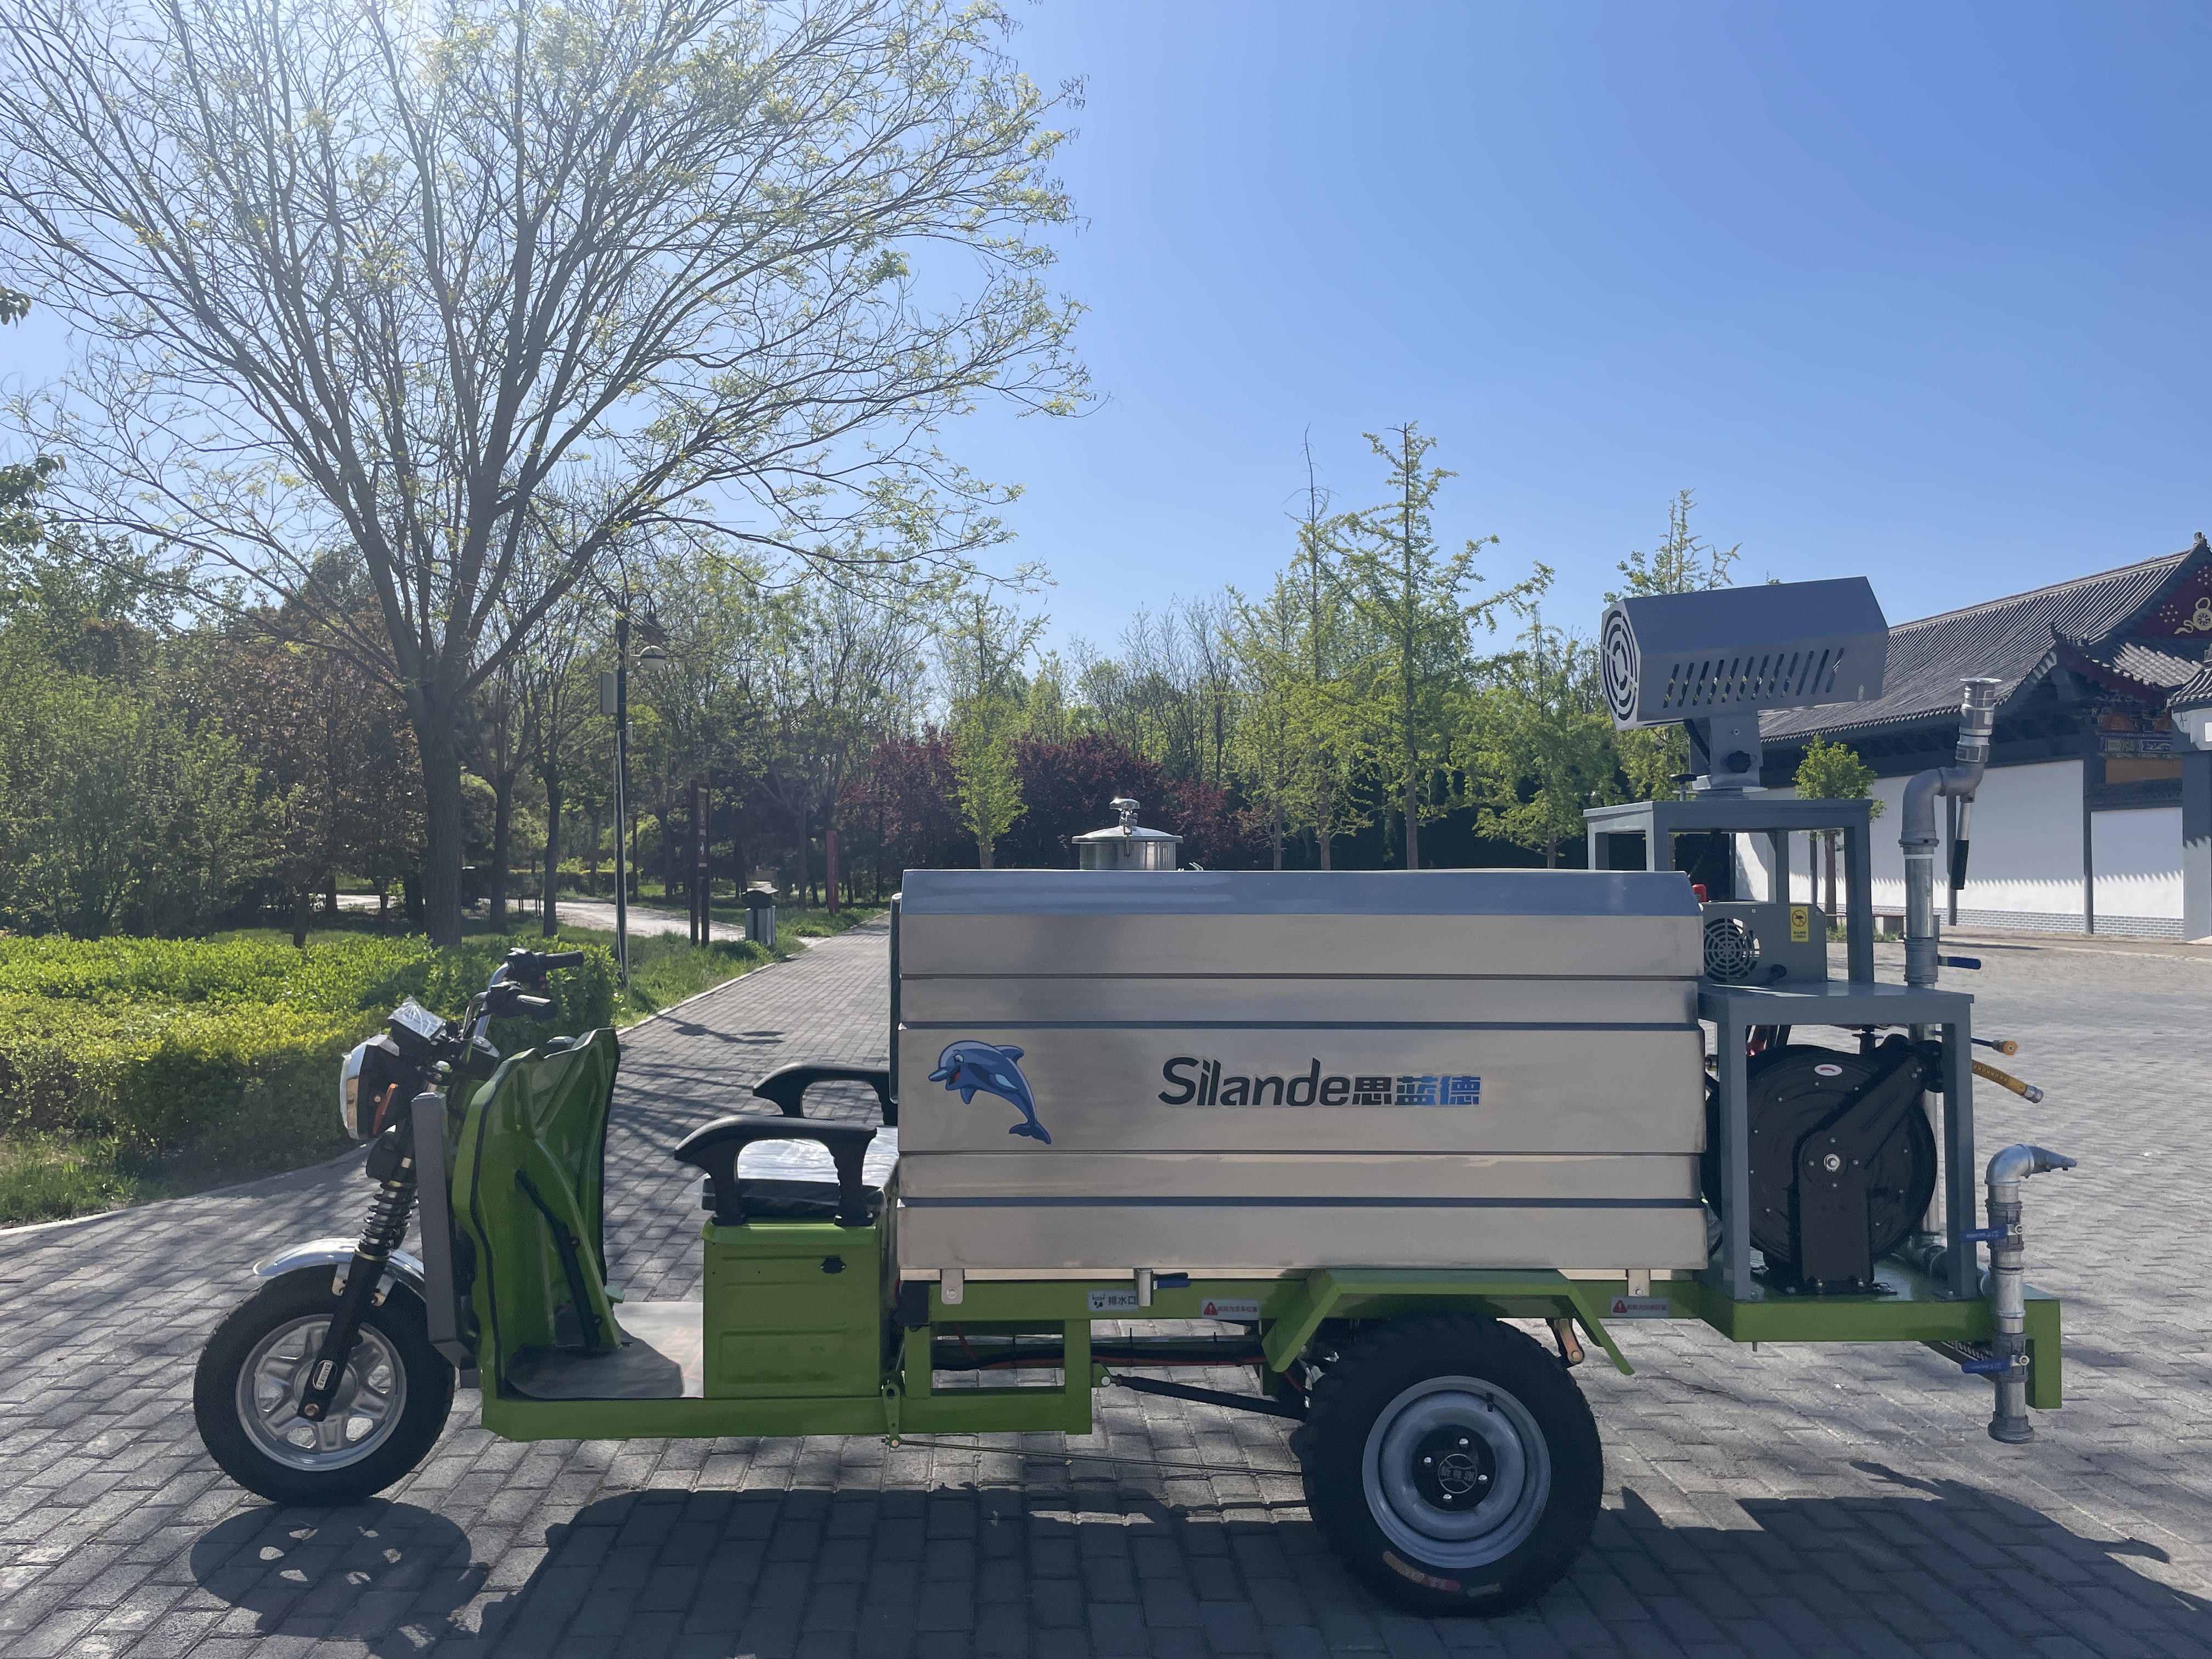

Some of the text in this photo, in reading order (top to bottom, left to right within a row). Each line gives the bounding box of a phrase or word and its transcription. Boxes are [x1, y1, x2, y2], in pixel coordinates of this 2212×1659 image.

[1158, 1057, 1350, 1107] Silande
[1351, 1075, 1481, 1106] 思蓝德
[1108, 1295, 1136, 1305] 排水口
